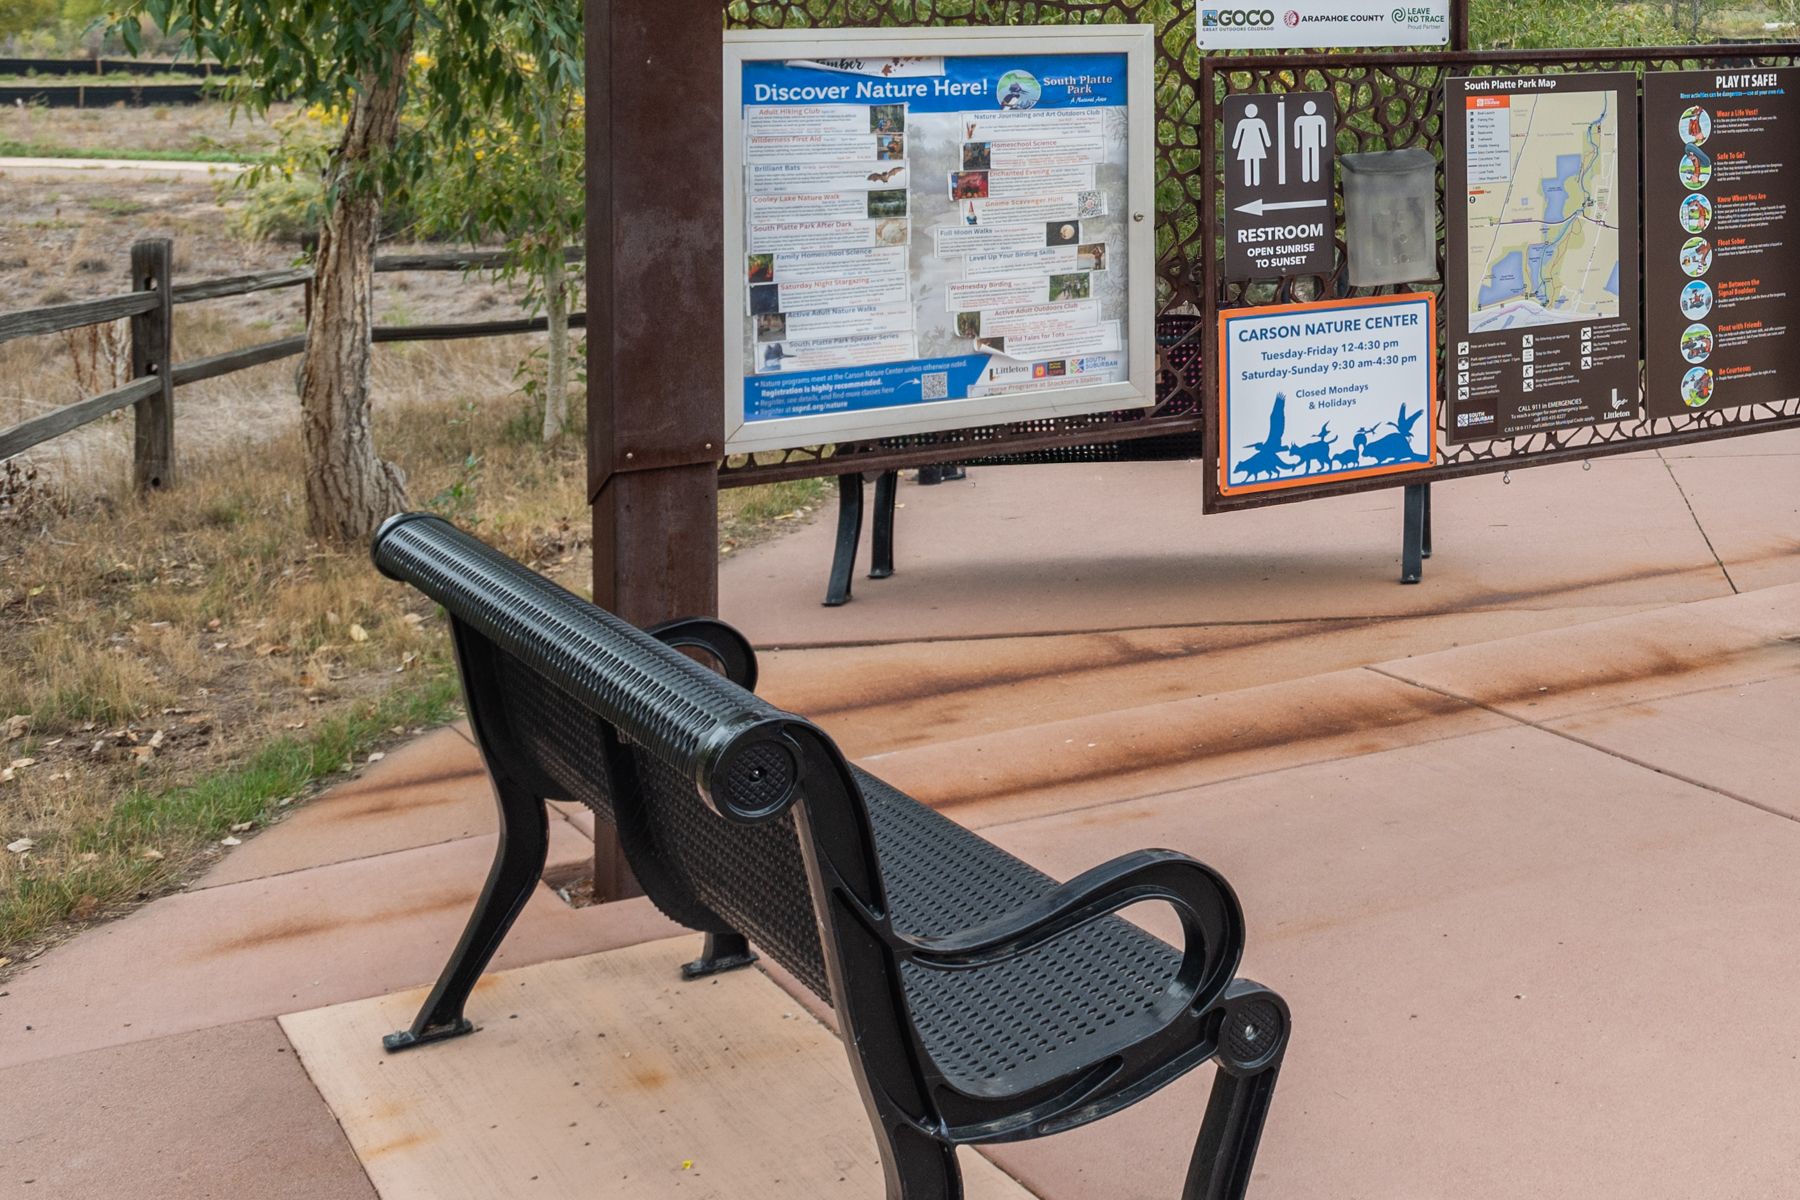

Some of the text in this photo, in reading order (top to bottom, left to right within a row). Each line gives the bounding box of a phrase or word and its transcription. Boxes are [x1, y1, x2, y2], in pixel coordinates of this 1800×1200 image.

[1407, 7, 1431, 15] LEAVE
[1218, 9, 1275, 26] GOCO
[1301, 13, 1385, 23] ARAPAHOE COUNTY
[1407, 14, 1445, 23] NO TRACE
[1043, 75, 1113, 86] South Platte
[1464, 78, 1557, 91] South Platte Park Map
[1715, 73, 1778, 89] PLAY IT SAFE!
[754, 78, 988, 101] Discover Nature Here!
[1067, 84, 1092, 94] Park
[759, 107, 820, 116] Adult Hiking Club
[974, 112, 996, 120] Nature
[998, 111, 1032, 120] Journaling
[1046, 110, 1056, 118] Art
[751, 135, 821, 144] Wilderness First Aid
[992, 139, 1057, 149] Homeschool Science
[1716, 152, 1729, 160] Safe
[1736, 151, 1746, 159] Go?
[754, 164, 783, 172] Brilliant
[1025, 168, 1051, 177] Evening
[753, 192, 839, 204] Cooley Lake Nature Walk
[1731, 194, 1748, 202] Where
[753, 220, 852, 233] South Platte Park After Dark
[940, 226, 993, 236] Full Moon Walks
[1237, 223, 1324, 244] RESTROOM
[1717, 238, 1746, 246] Float Sober
[776, 248, 872, 261] Family Homeschool Science
[969, 248, 1056, 262] Level Up Your Birding Skills
[1247, 243, 1315, 257] OPEN SUNRISE
[1256, 255, 1307, 268] TO SUNSET
[780, 277, 870, 291] Saturday Night Stargazing
[950, 280, 1012, 291] Wednesday Birding
[788, 305, 877, 318] Active Adult Nature Walks
[994, 302, 1078, 317] Active Adult Outdoors Club
[1238, 313, 1418, 343] CARSON NATURE CENTER
[1718, 324, 1732, 332] Float
[1743, 320, 1762, 329] Friends
[789, 340, 811, 348] South
[833, 337, 849, 345] Park
[850, 336, 877, 344] Speaker
[878, 333, 899, 341] Series
[1007, 330, 1065, 343] Wild Tales for Tots
[1261, 339, 1399, 361] Tuesday-Friday 12-4:30 pm
[995, 365, 1029, 375] Littleton
[1085, 360, 1118, 369] SUBURBAN
[1241, 354, 1417, 381] Saturday-Sunday 9:30 am-4:30 pm
[1719, 367, 1726, 375] Be
[1726, 366, 1752, 374] Courteous
[761, 386, 804, 398] Registration
[811, 383, 833, 394] highly
[834, 378, 883, 390] recommended.
[1295, 383, 1369, 399] Closed Mondays
[1308, 397, 1357, 410] & Holidays
[1517, 404, 1531, 412] CALL
[1532, 402, 1541, 411] 911
[1547, 398, 1582, 408] EMERGENCIES
[1468, 414, 1495, 423] SUBURBAN
[1603, 410, 1631, 420] Littleton
